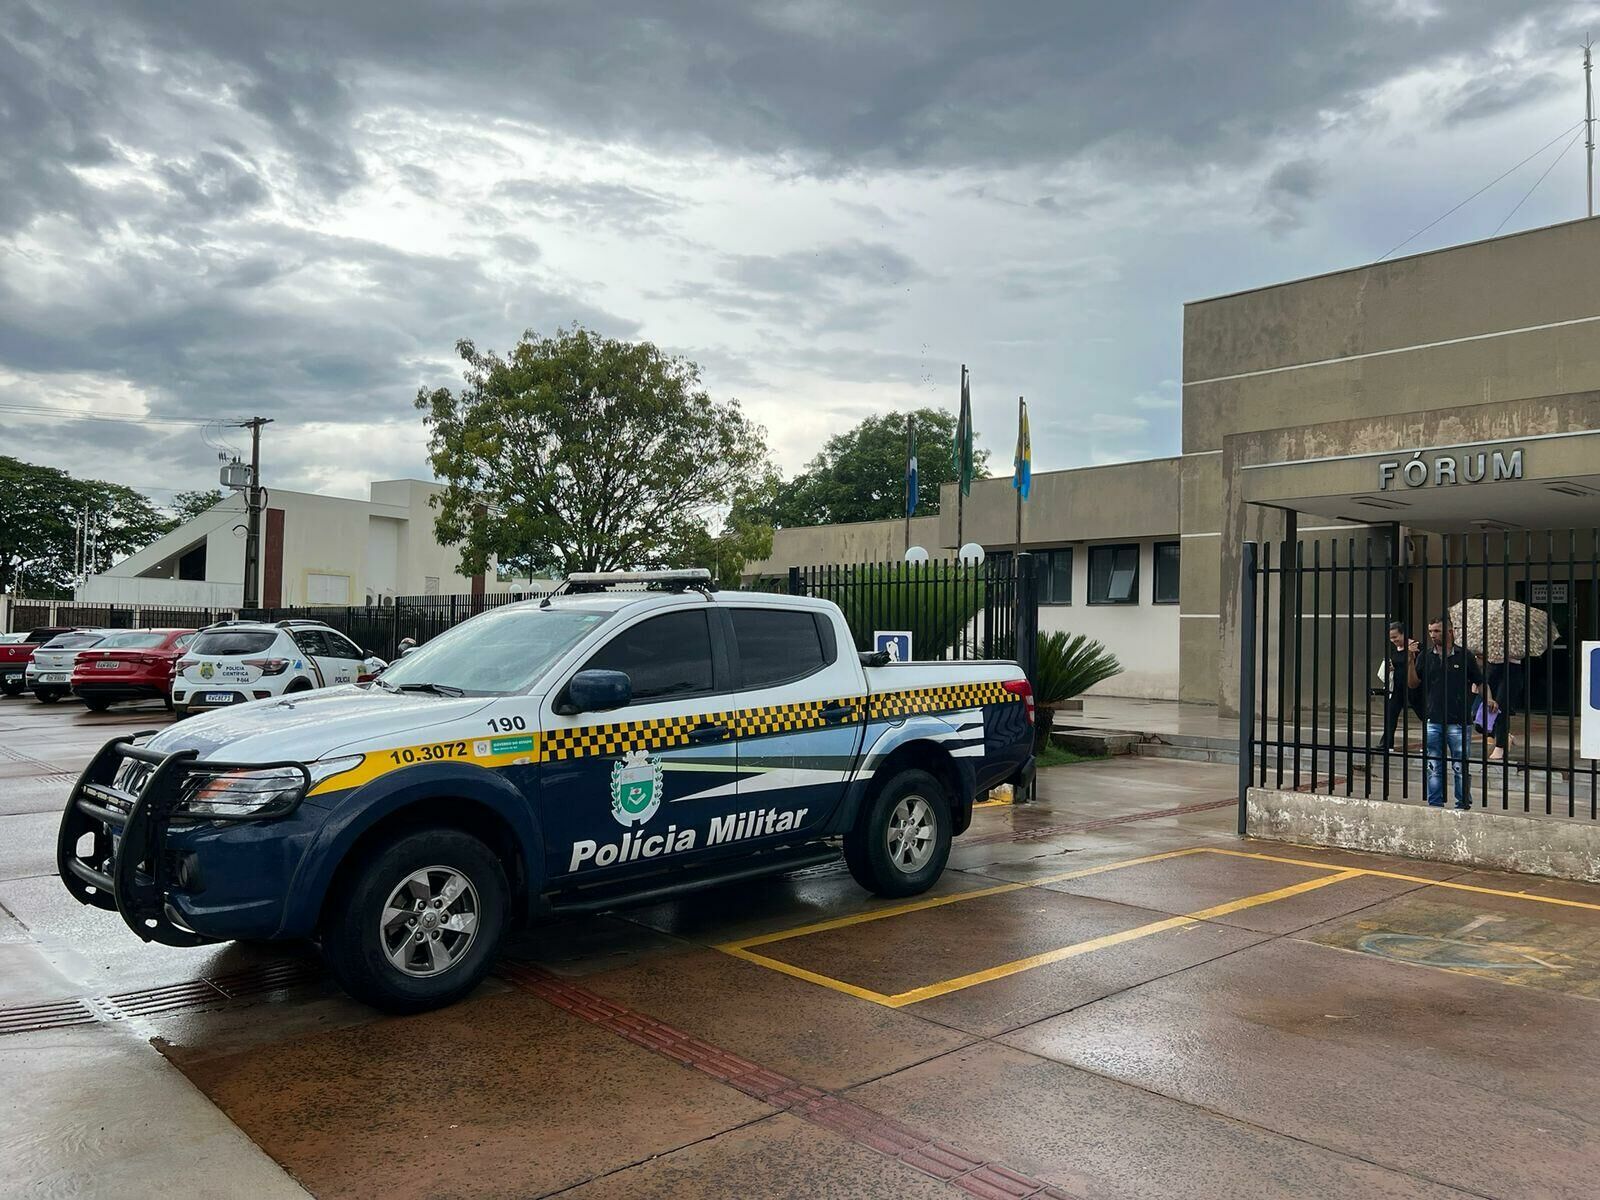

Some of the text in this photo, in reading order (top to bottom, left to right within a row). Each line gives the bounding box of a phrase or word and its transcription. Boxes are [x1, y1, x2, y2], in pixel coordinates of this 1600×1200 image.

[1379, 450, 1523, 489] FÓRUM
[487, 716, 526, 733] 190
[390, 742, 468, 764] 10.3072
[568, 808, 808, 872] Polícia Militar
